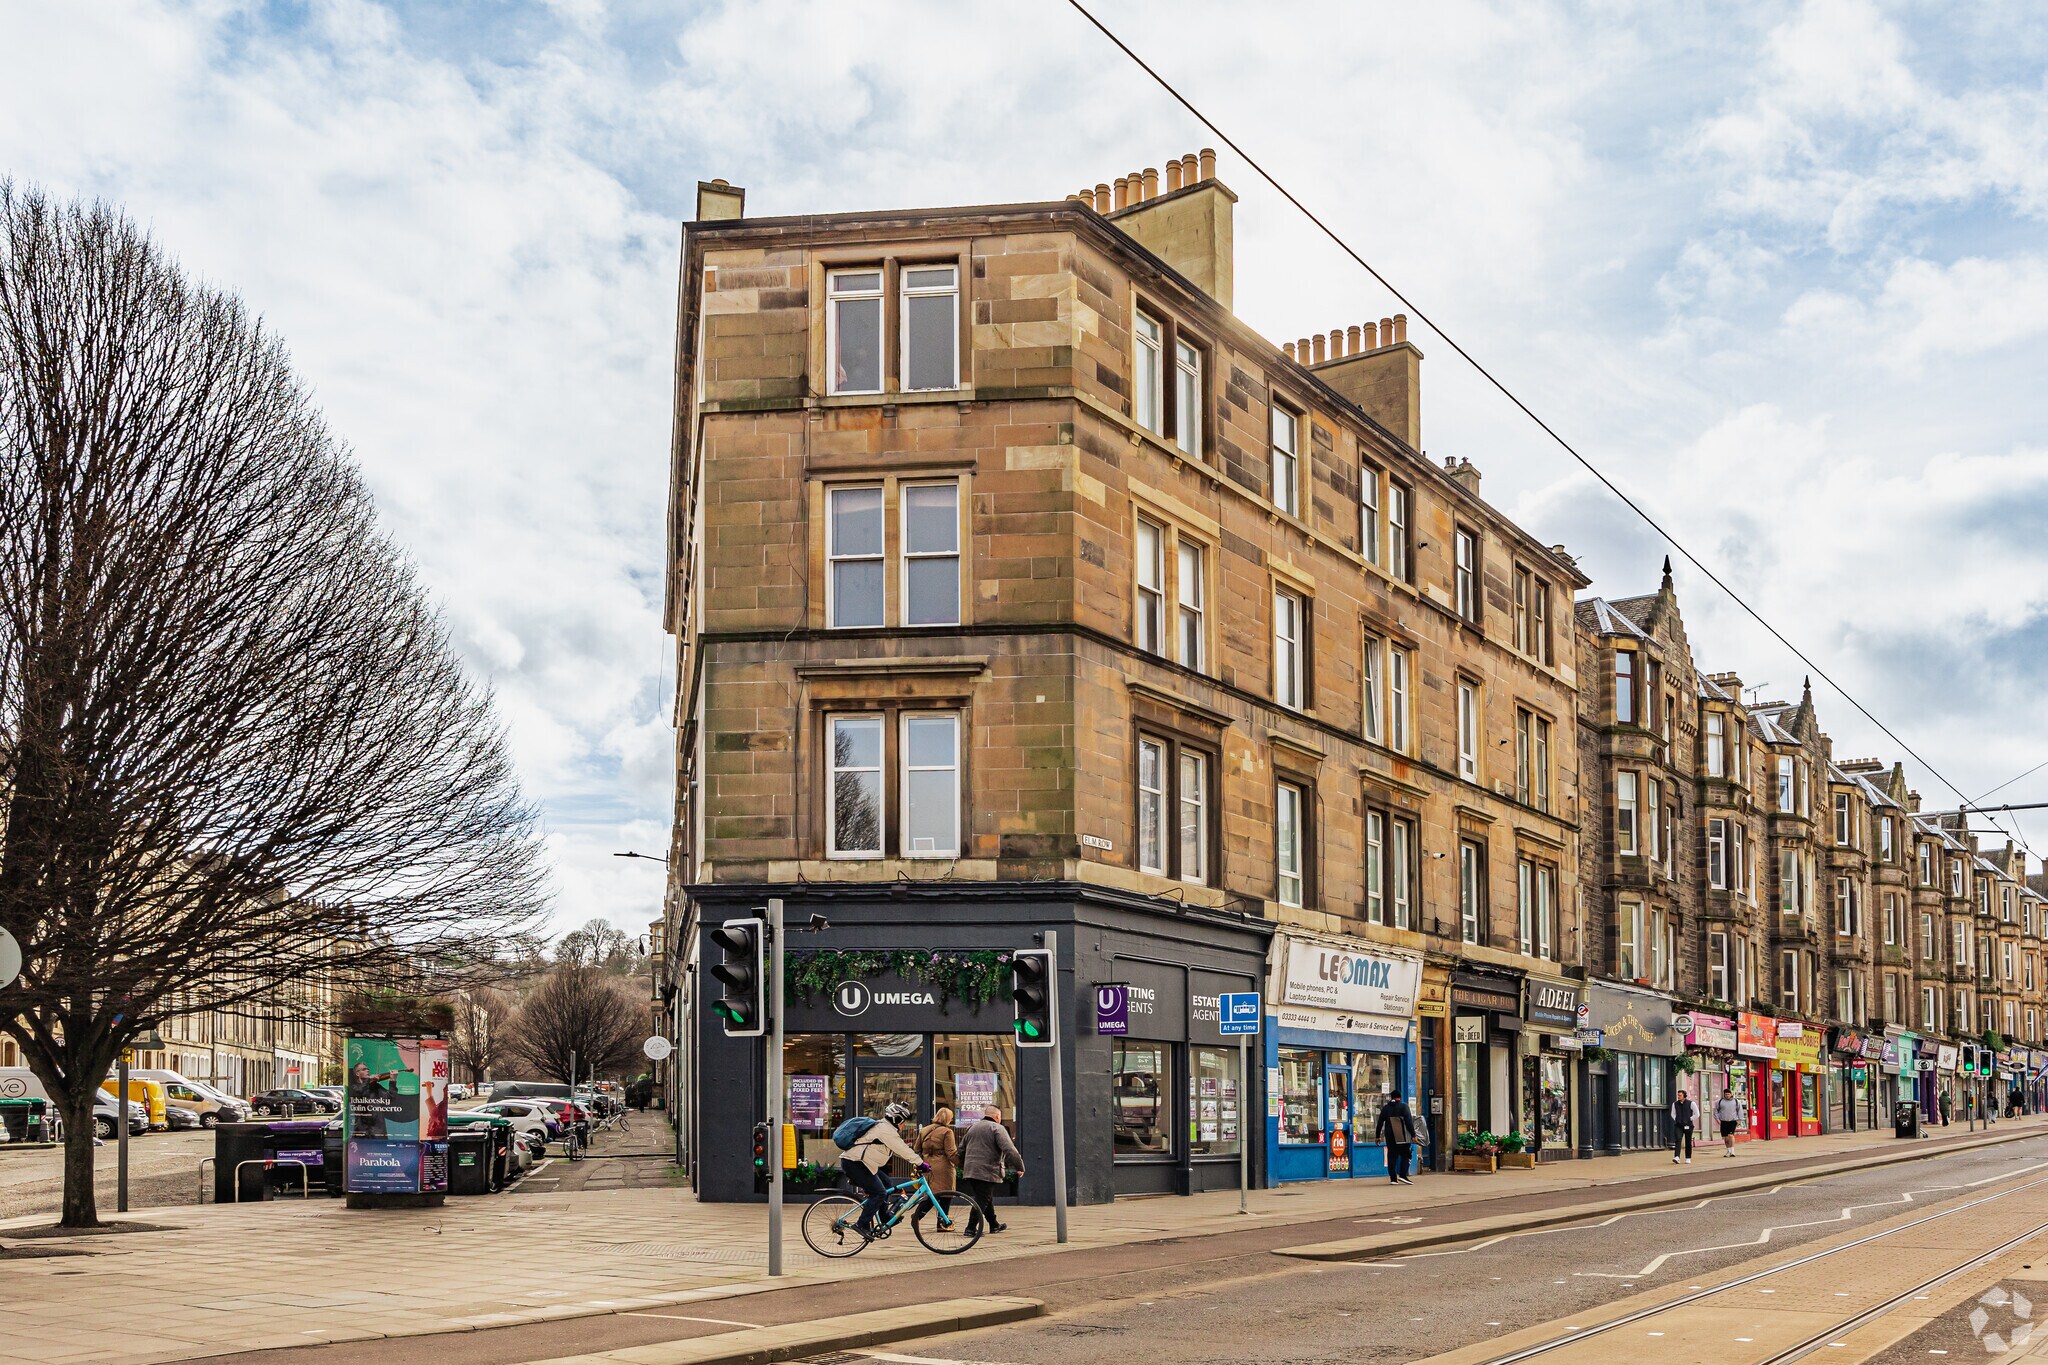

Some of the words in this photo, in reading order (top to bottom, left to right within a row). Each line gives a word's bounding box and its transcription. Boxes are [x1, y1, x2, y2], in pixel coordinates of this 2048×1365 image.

[1319, 953, 1392, 989] LEOMAX
[1289, 981, 1307, 991] Mobile
[1306, 985, 1325, 994] phones,
[874, 992, 934, 1004] UMEGA
[1289, 992, 1307, 1002] Laptop
[1308, 995, 1336, 1004] Accessories
[1380, 993, 1394, 1002] Repair
[1394, 995, 1410, 1003] Service
[1454, 990, 1469, 1001] THE
[1472, 993, 1498, 1005] CIGAR
[1538, 987, 1576, 1012] ADEEL
[1384, 1003, 1404, 1013] Stationary
[1282, 1013, 1298, 1021] 03333
[1354, 1020, 1368, 1030] Repair
[1374, 1022, 1388, 1030] Service
[1604, 1022, 1622, 1037] JOKER
[1622, 1017, 1627, 1027] &
[1628, 1014, 1638, 1029] THE
[1638, 1026, 1654, 1042] THIEF
[350, 1097, 390, 1105] Tchaikovsky
[1333, 1134, 1344, 1147] ria
[360, 1158, 400, 1166] Parabola
